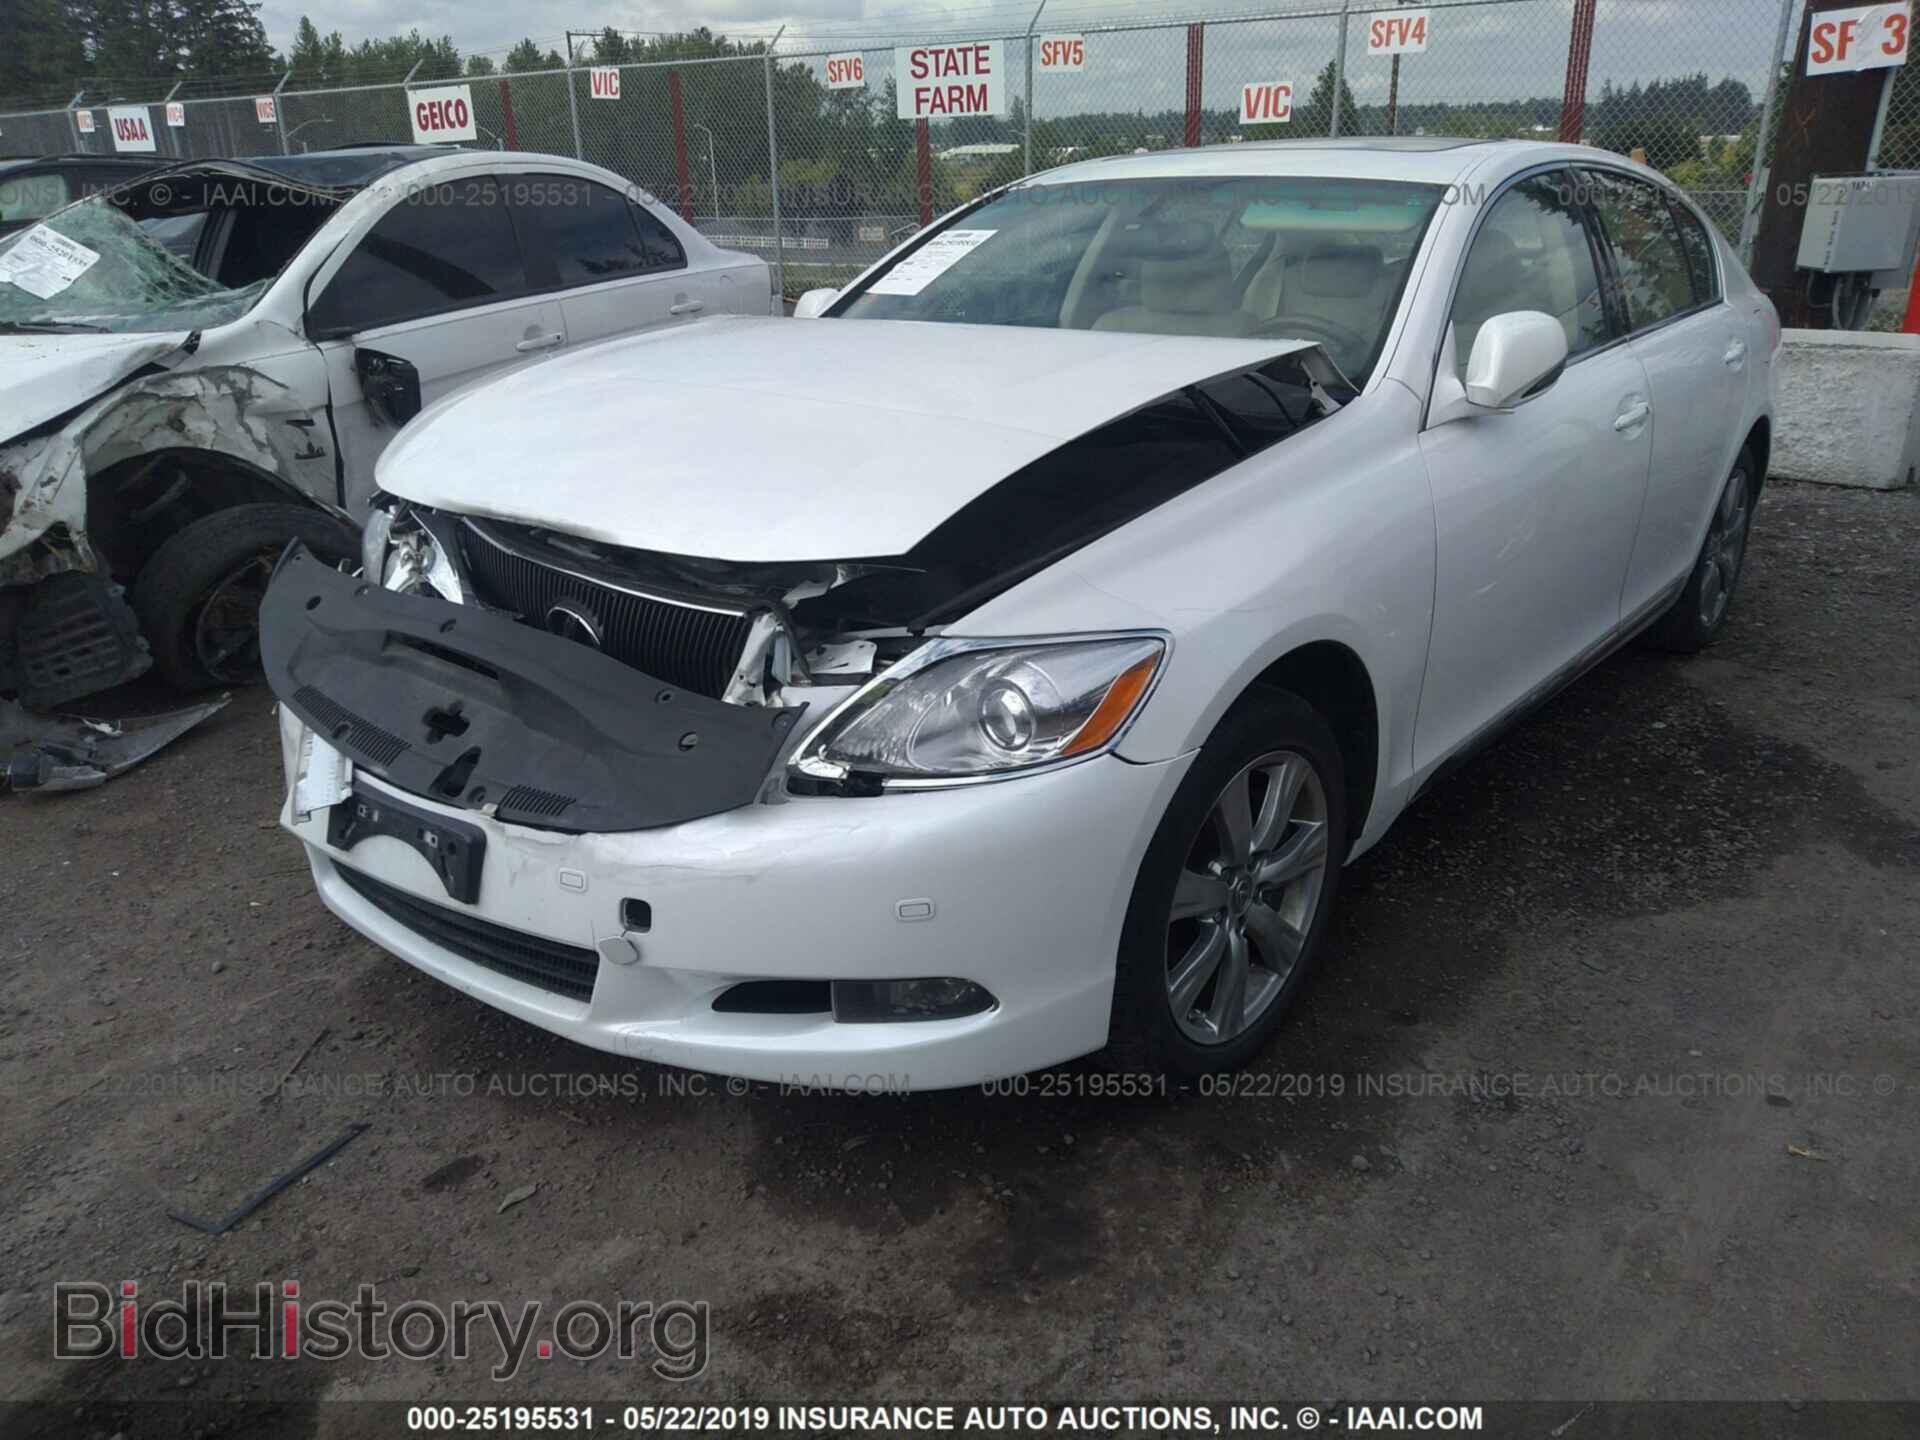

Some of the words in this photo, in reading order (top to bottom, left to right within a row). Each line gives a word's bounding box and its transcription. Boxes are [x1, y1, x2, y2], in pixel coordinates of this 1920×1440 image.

[1370, 16, 1426, 48] SFV4
[910, 44, 991, 80] STATE
[1041, 40, 1084, 66] SFV5
[592, 71, 619, 96] VIC
[828, 57, 863, 83] SFV6
[416, 98, 468, 132] GEICO
[915, 83, 988, 115] FARM
[1244, 85, 1291, 120] VIC
[114, 118, 149, 141] USAA
